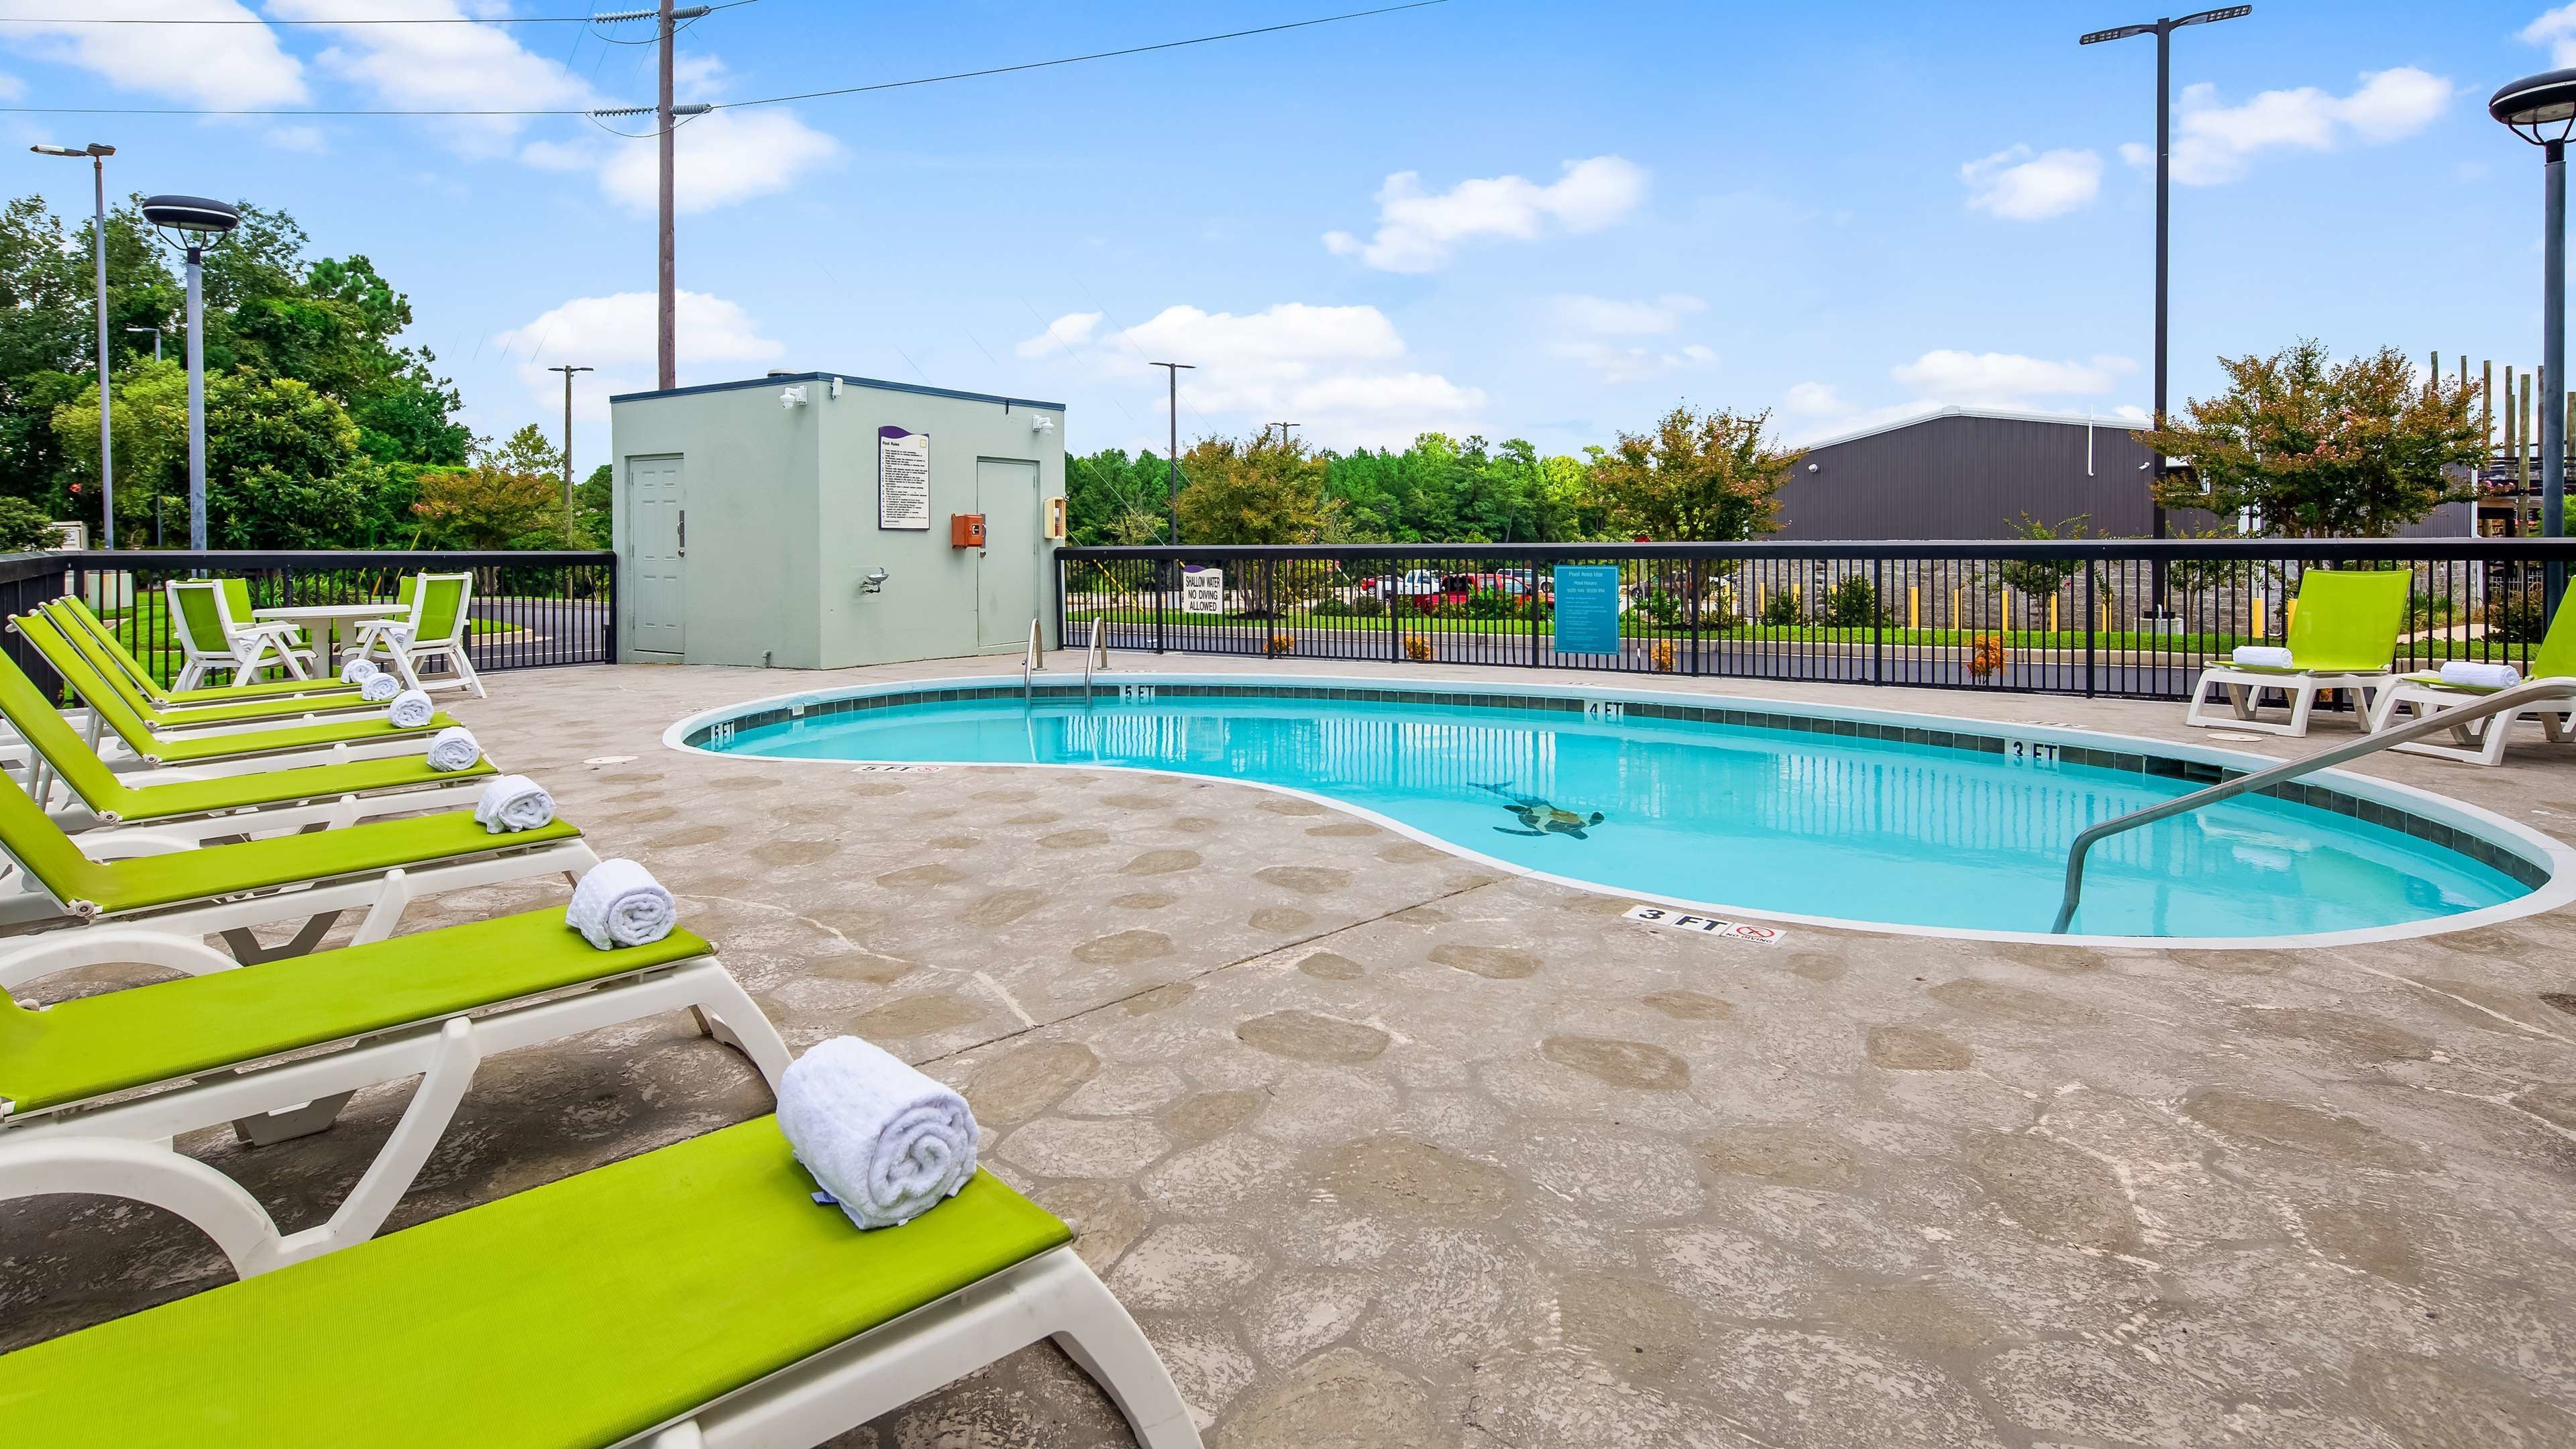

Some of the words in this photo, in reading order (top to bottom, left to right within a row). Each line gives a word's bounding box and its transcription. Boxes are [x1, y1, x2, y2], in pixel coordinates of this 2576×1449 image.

[1186, 576, 1205, 587] SHALLOW
[1206, 577, 1220, 588] WATER
[1188, 590, 1196, 599] NO
[1199, 590, 1218, 600] DIVING
[1190, 601, 1217, 611] ALLOWED
[1125, 685, 1132, 696] 5
[1138, 685, 1154, 696] FT
[1589, 702, 1598, 712] 4
[1605, 702, 1622, 714] FT
[722, 721, 733, 737] FT
[2013, 741, 2023, 756] 3
[2033, 743, 2057, 760] FT
[1638, 909, 1666, 920] 3
[1674, 916, 1727, 931] FT
[1741, 935, 1772, 943] DIVING
